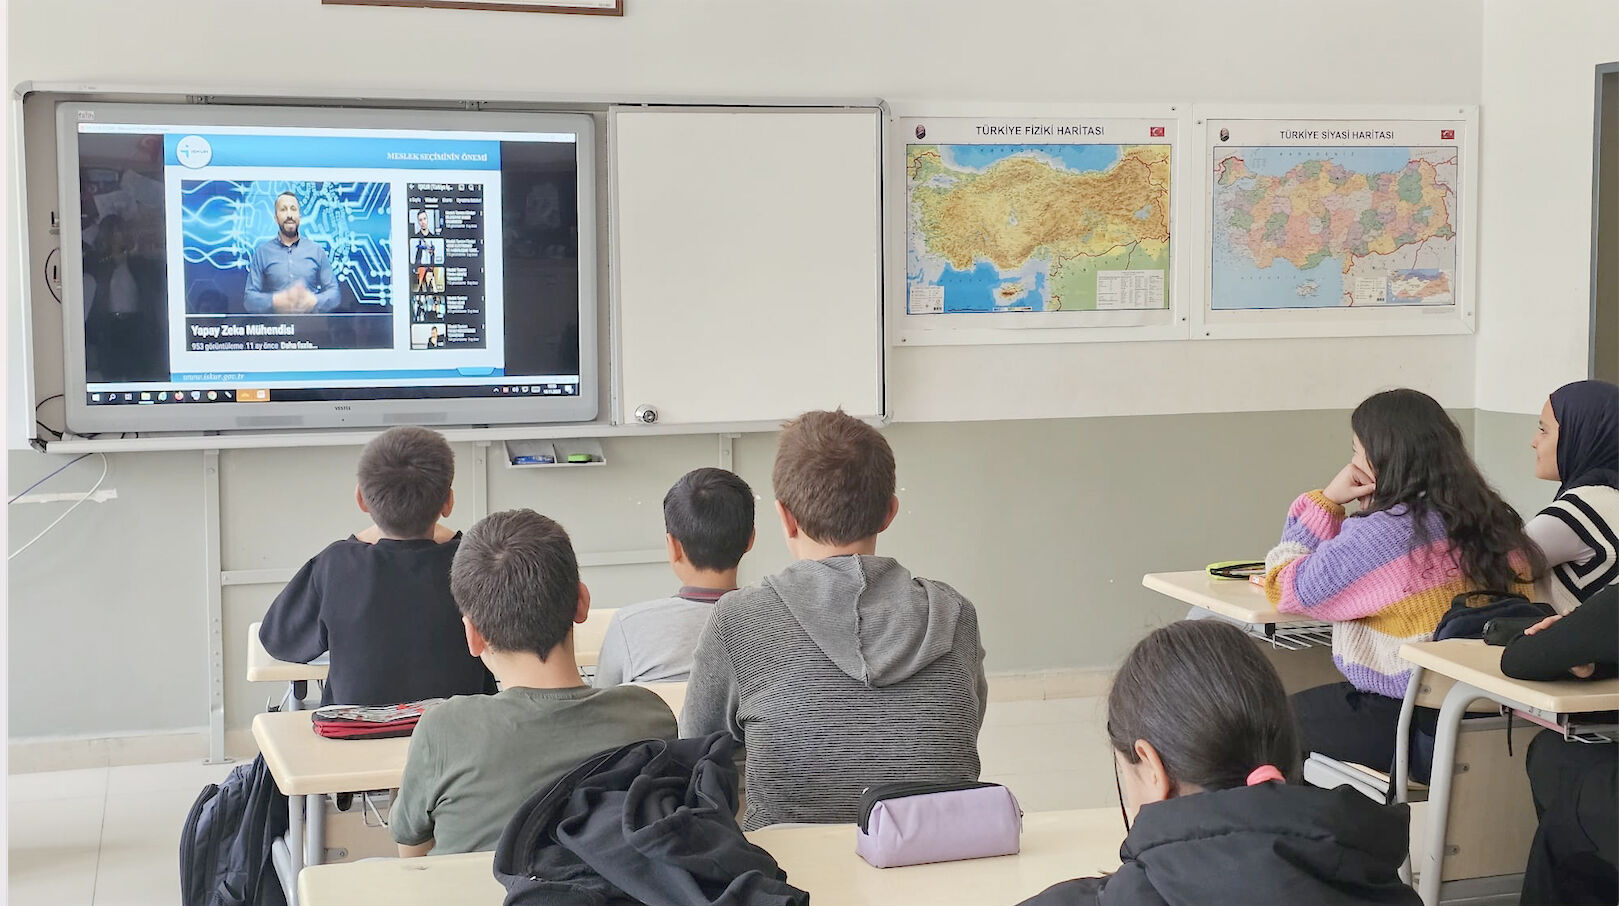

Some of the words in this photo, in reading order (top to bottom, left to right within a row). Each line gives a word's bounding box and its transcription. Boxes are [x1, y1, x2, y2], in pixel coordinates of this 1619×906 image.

[976, 124, 1022, 136] TÜRKİYE
[1025, 124, 1054, 136] FİZİKİ
[1057, 124, 1105, 136] HARİTASI
[1280, 129, 1320, 140] TÜRKİYE
[1321, 129, 1350, 140] SİYASİ
[1352, 129, 1394, 140] HARİTASI
[387, 152, 420, 160] MESLEK
[420, 152, 460, 161] SEÇİMİNİN
[461, 152, 488, 161] ÖNEMİ
[191, 325, 220, 338] Yapay
[221, 325, 245, 336] Zeka
[245, 324, 295, 336] Mühendisi
